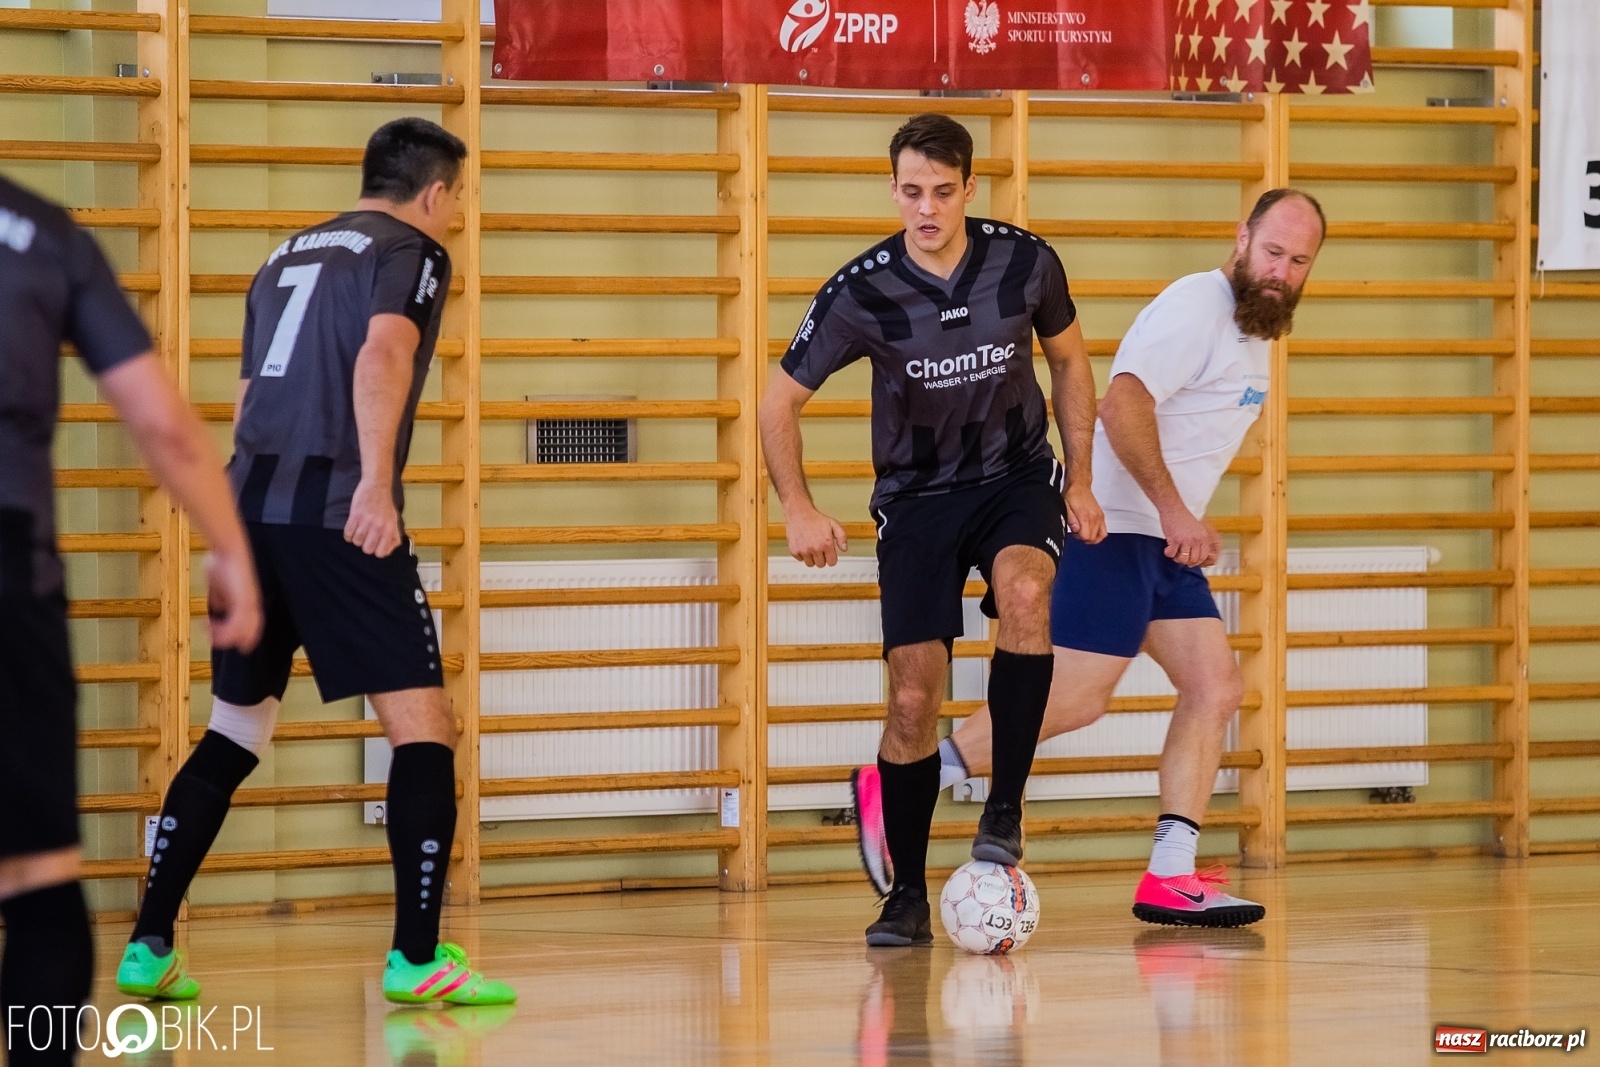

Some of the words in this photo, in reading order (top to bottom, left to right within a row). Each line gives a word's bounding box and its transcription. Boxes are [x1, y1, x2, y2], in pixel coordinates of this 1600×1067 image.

[834, 13, 898, 44] ZPRP
[1007, 11, 1087, 25] MINISTERSTWO
[1007, 29, 1047, 43] SPORTU
[1048, 30, 1053, 43] I
[1055, 30, 1112, 43] TURYSTYKI
[426, 276, 438, 299] PIO
[260, 262, 323, 377] 7
[940, 306, 969, 322] JAKO
[800, 319, 815, 342] PIO
[905, 342, 1015, 379] ChomTec
[924, 376, 962, 390] WASSER
[969, 365, 1007, 382] ENERGIE
[985, 913, 1013, 931] ECT
